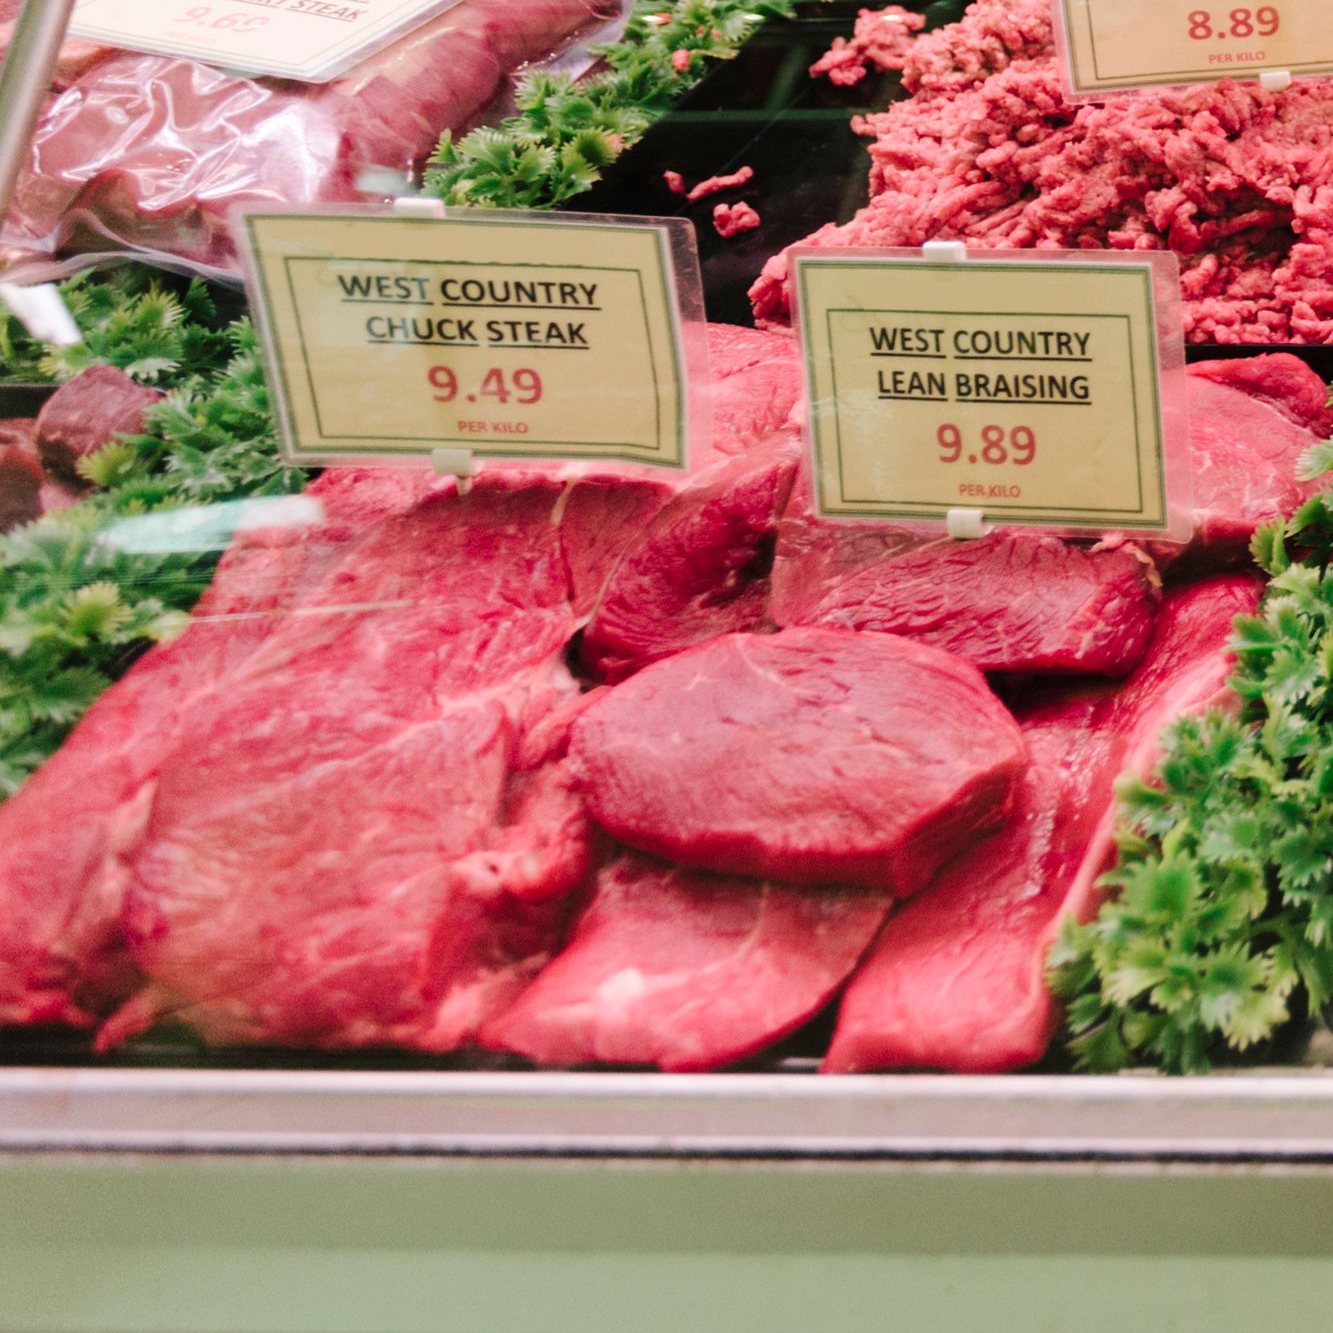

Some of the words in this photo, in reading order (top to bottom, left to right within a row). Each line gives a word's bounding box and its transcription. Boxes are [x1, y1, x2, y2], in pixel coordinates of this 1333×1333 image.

[173, 6, 271, 33] 9.69
[1187, 6, 1281, 41] 8.89
[1208, 52, 1233, 64] PER
[1236, 50, 1266, 62] KILO
[337, 274, 429, 300] WEST
[440, 278, 599, 306] COUNTRY
[366, 316, 478, 341] CHUCK
[486, 321, 588, 345] STEAK
[869, 327, 944, 353] WEST
[953, 330, 1090, 356] COUNTRY
[427, 365, 543, 405] 9.49
[878, 370, 946, 396] LEAN
[955, 373, 1089, 400] BRAISING
[457, 420, 488, 434] PER
[491, 421, 528, 435] KILO
[936, 423, 1036, 466] 9.89
[958, 483, 986, 497] PER
[988, 484, 1021, 498] KILO
